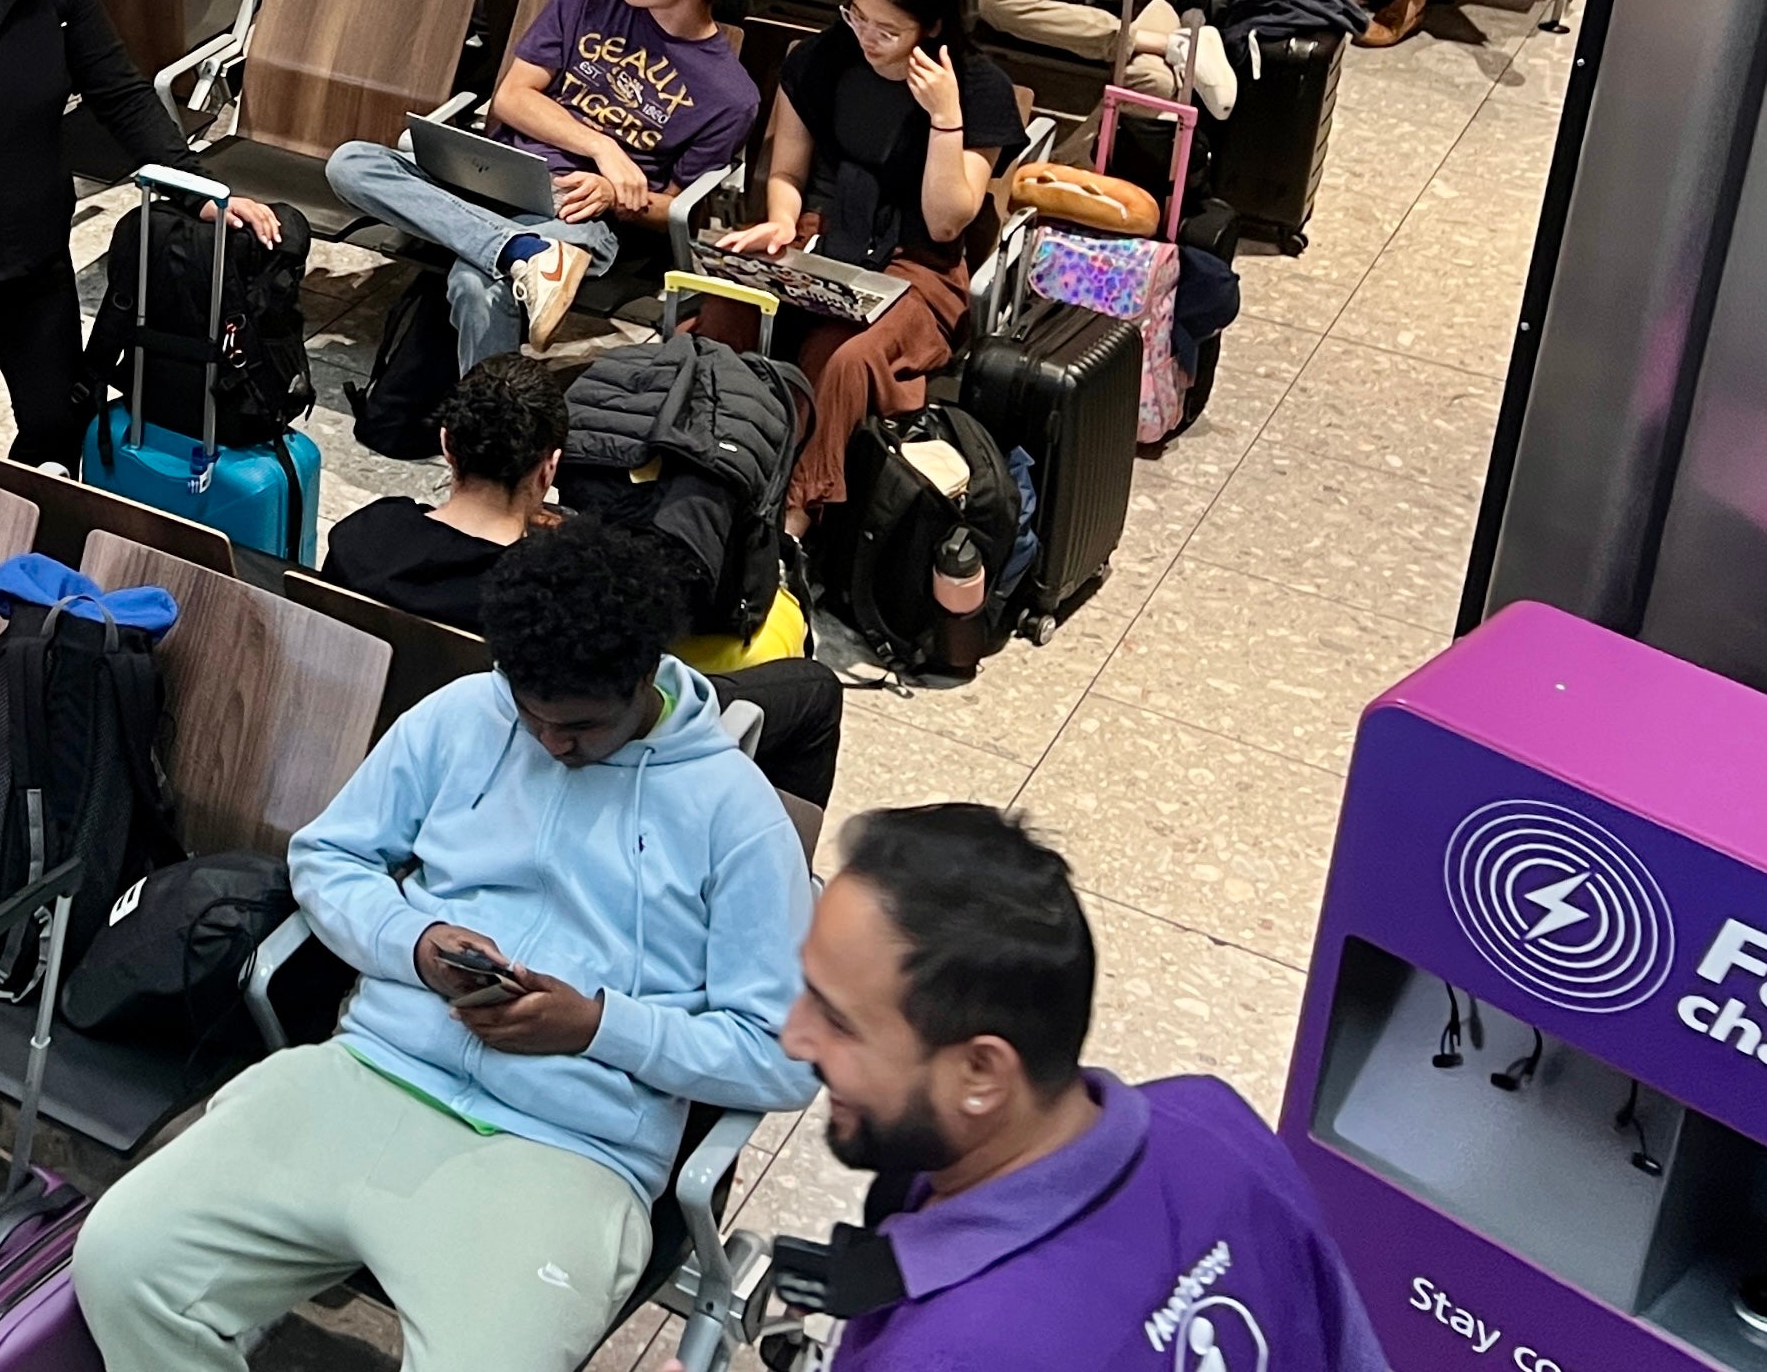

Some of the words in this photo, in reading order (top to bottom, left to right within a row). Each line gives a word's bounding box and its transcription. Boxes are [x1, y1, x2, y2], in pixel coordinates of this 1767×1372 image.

[578, 33, 694, 118] GEAUX
[579, 61, 603, 79] EST
[560, 71, 663, 151] TIGERS
[1409, 1276, 1501, 1353] Stay
